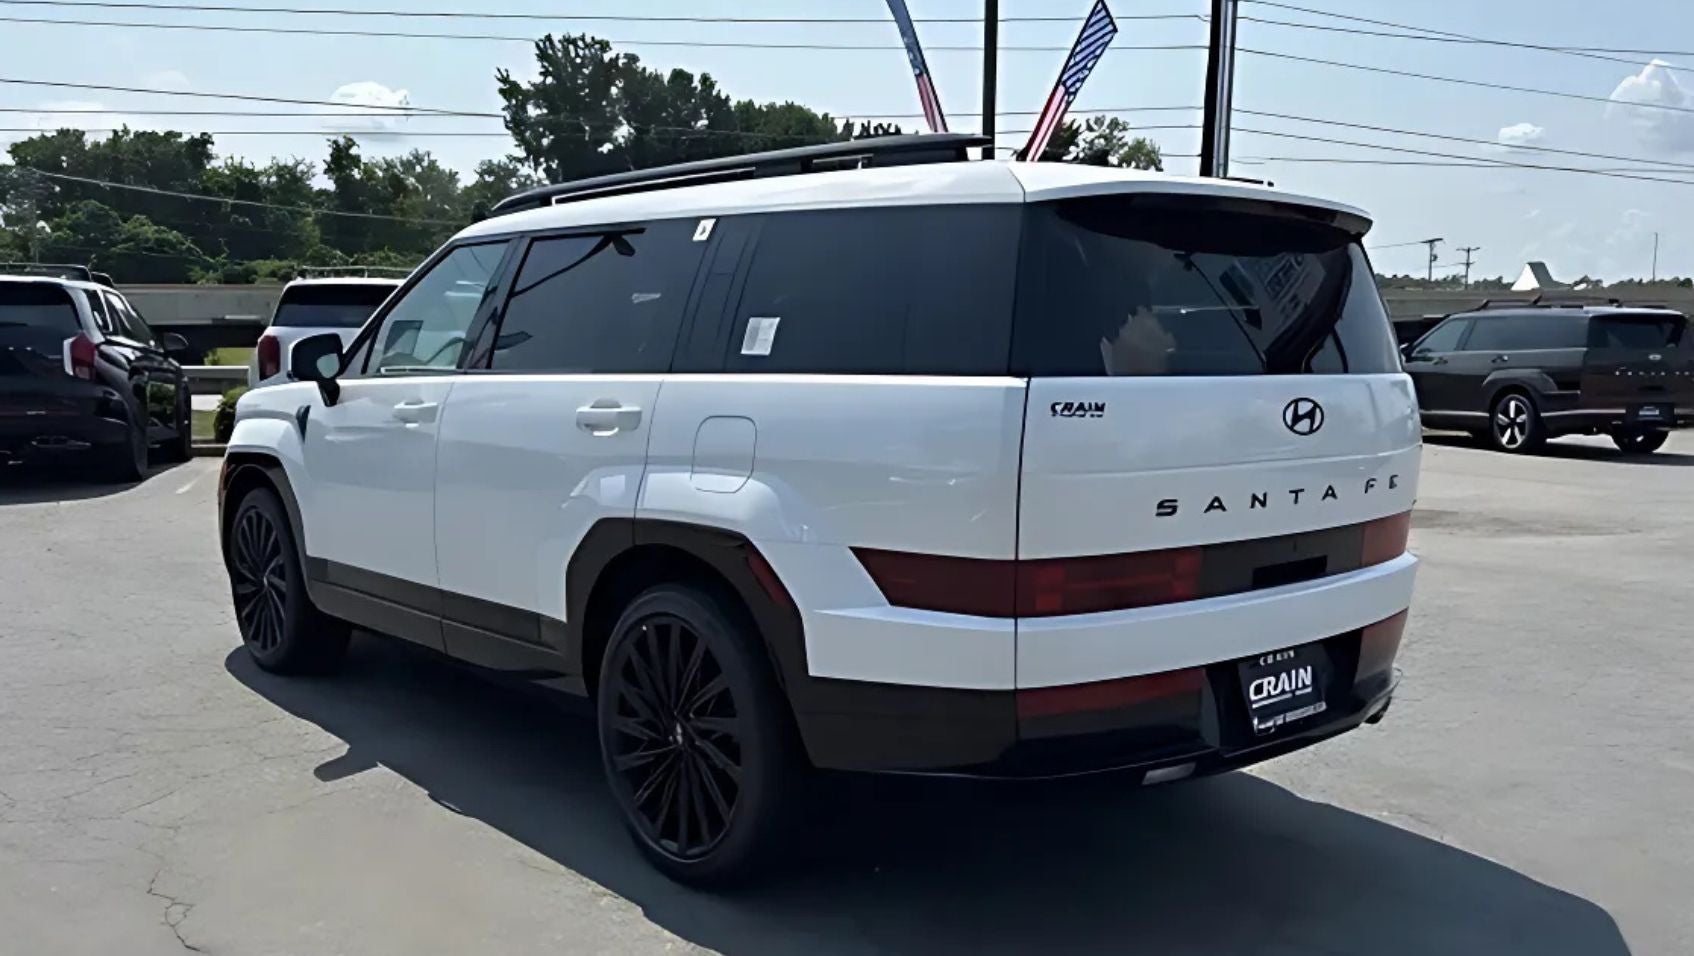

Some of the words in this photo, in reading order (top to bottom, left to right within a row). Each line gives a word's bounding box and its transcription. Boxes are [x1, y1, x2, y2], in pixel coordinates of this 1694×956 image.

[1051, 401, 1106, 415] CRAIN
[1155, 484, 1338, 517] SANTA
[1364, 474, 1399, 494] FE
[1249, 666, 1312, 701] CRAIN
